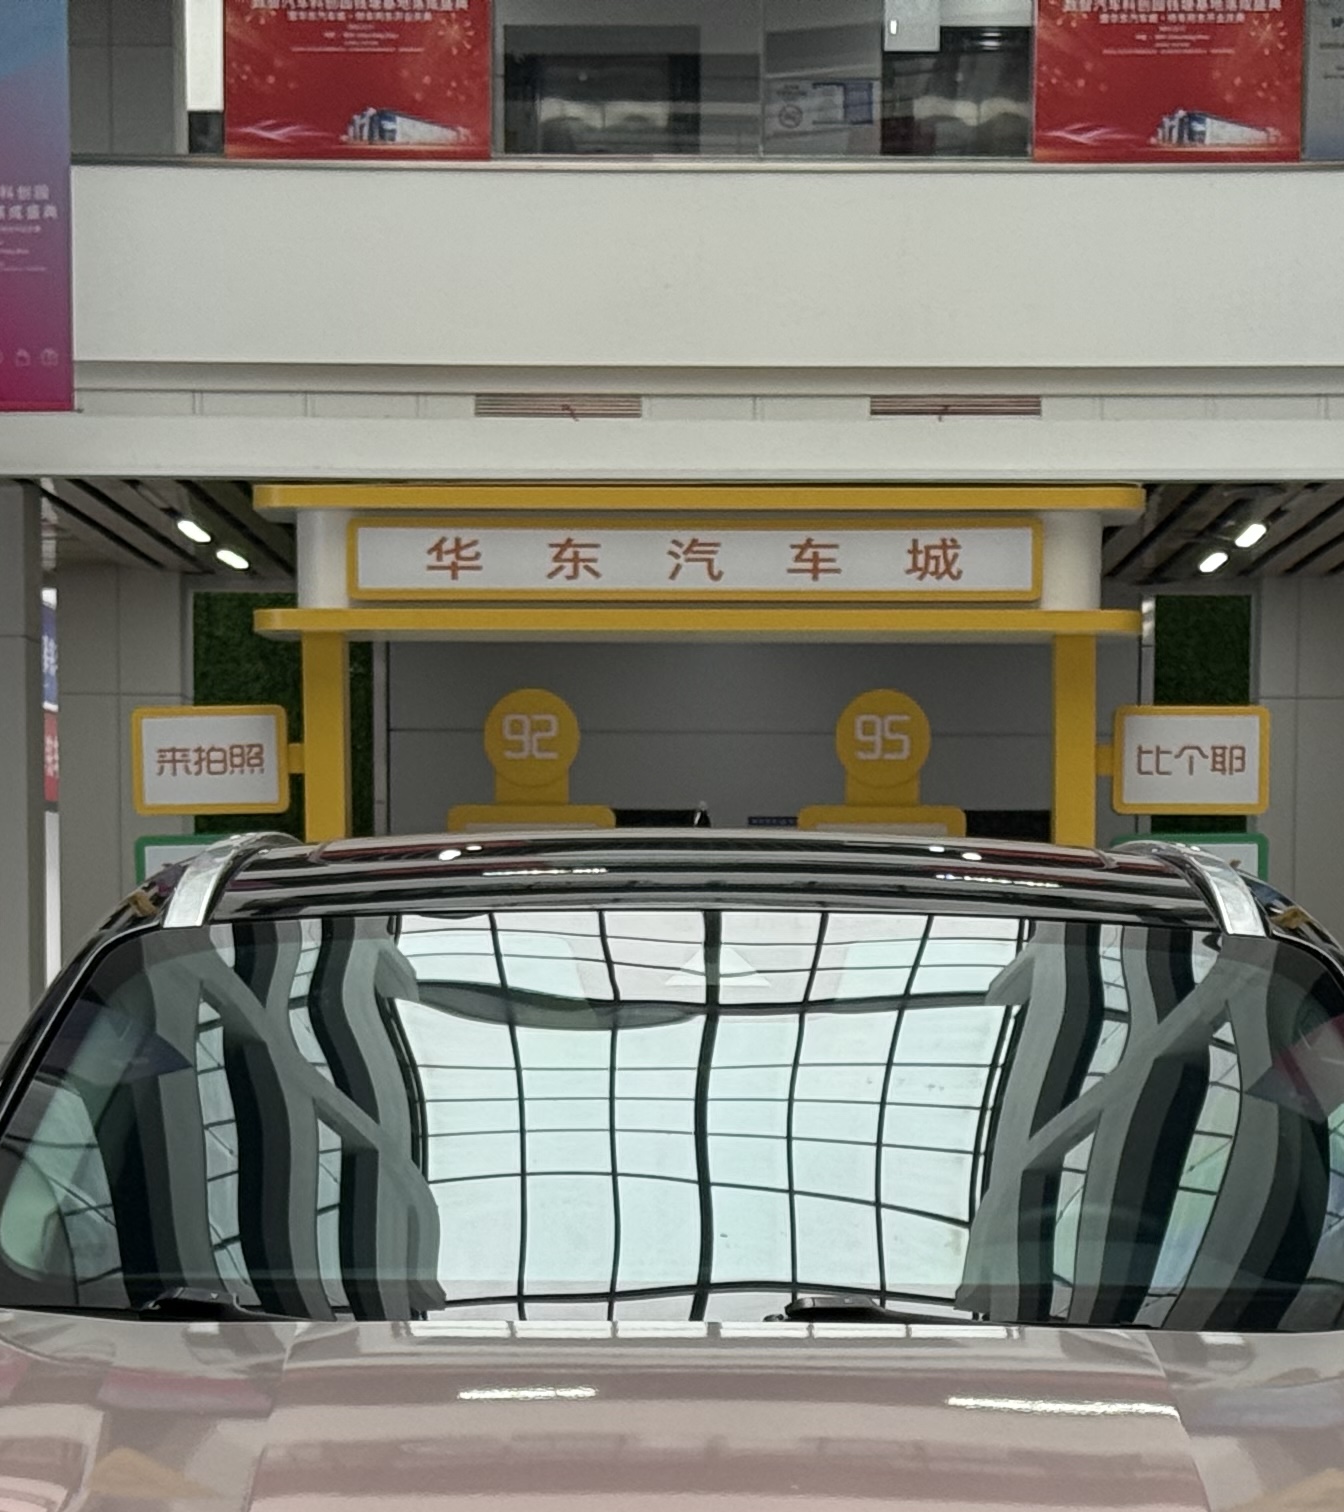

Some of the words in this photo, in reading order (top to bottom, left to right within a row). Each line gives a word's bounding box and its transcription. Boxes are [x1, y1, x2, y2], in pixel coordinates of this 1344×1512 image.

[426, 536, 964, 581] 华东汽车城
[503, 714, 558, 759] 92
[855, 714, 911, 760] 95
[155, 743, 265, 776] 来拍照
[1137, 744, 1246, 776] 比个耶
